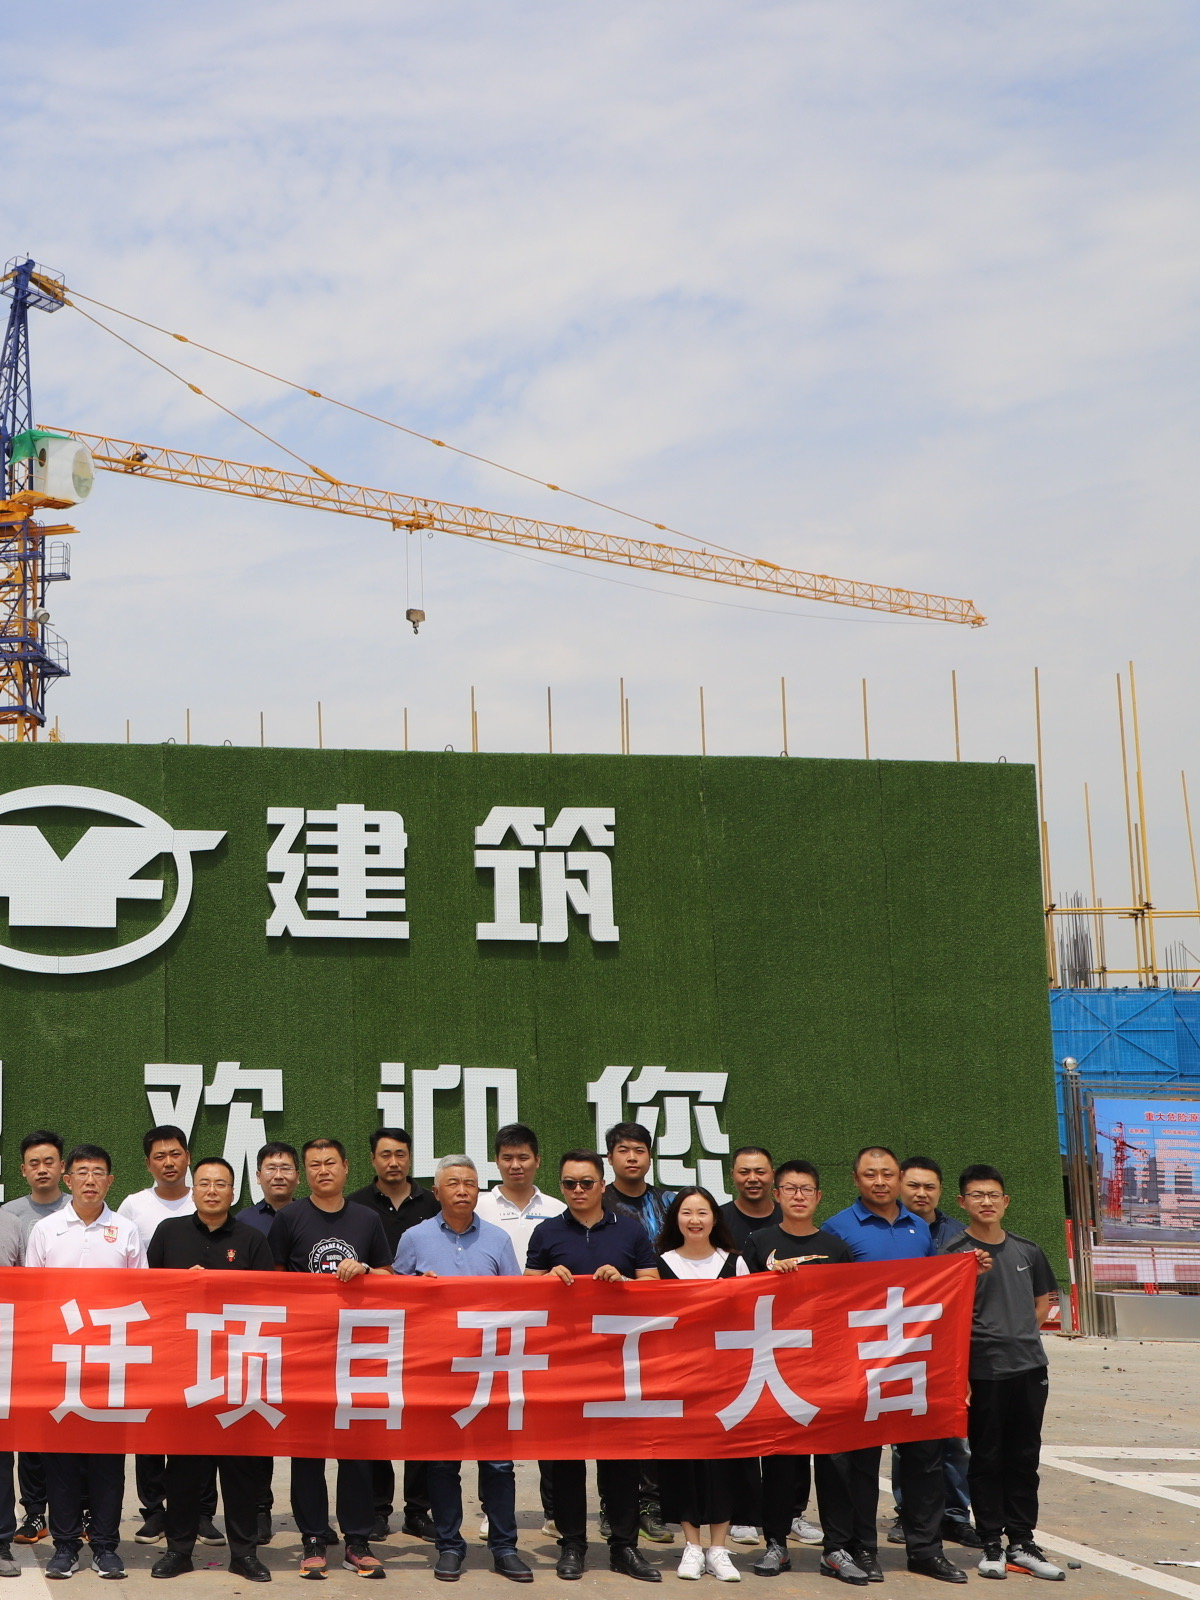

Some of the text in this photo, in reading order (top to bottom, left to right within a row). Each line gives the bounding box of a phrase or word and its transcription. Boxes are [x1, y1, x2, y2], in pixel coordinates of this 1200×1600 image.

[265, 803, 620, 943] 建筑
[1144, 1111, 1200, 1123] 重大危险源
